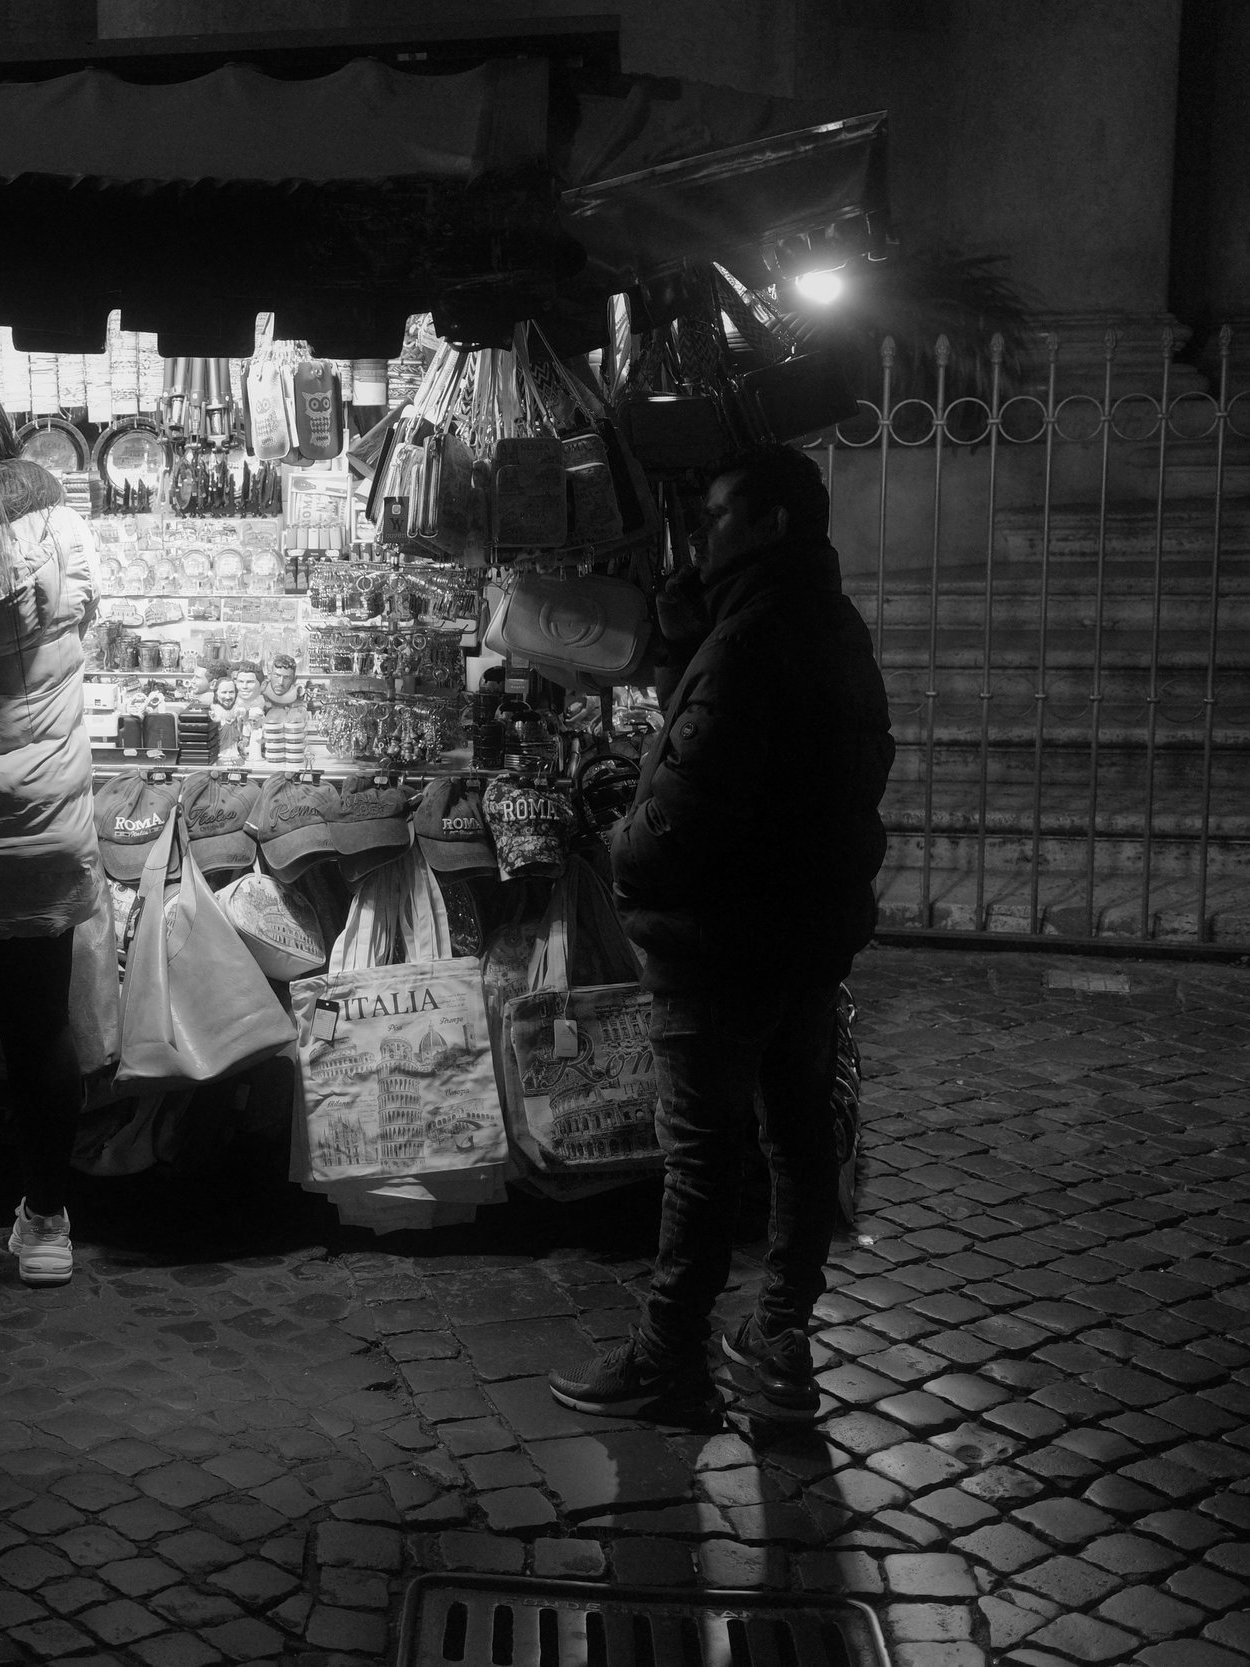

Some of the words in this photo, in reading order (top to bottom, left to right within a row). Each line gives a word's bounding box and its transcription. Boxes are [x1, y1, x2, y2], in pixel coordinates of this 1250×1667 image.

[500, 798, 560, 821] ROMA
[114, 812, 165, 831] ROMA
[342, 988, 441, 1022] ITALIA
